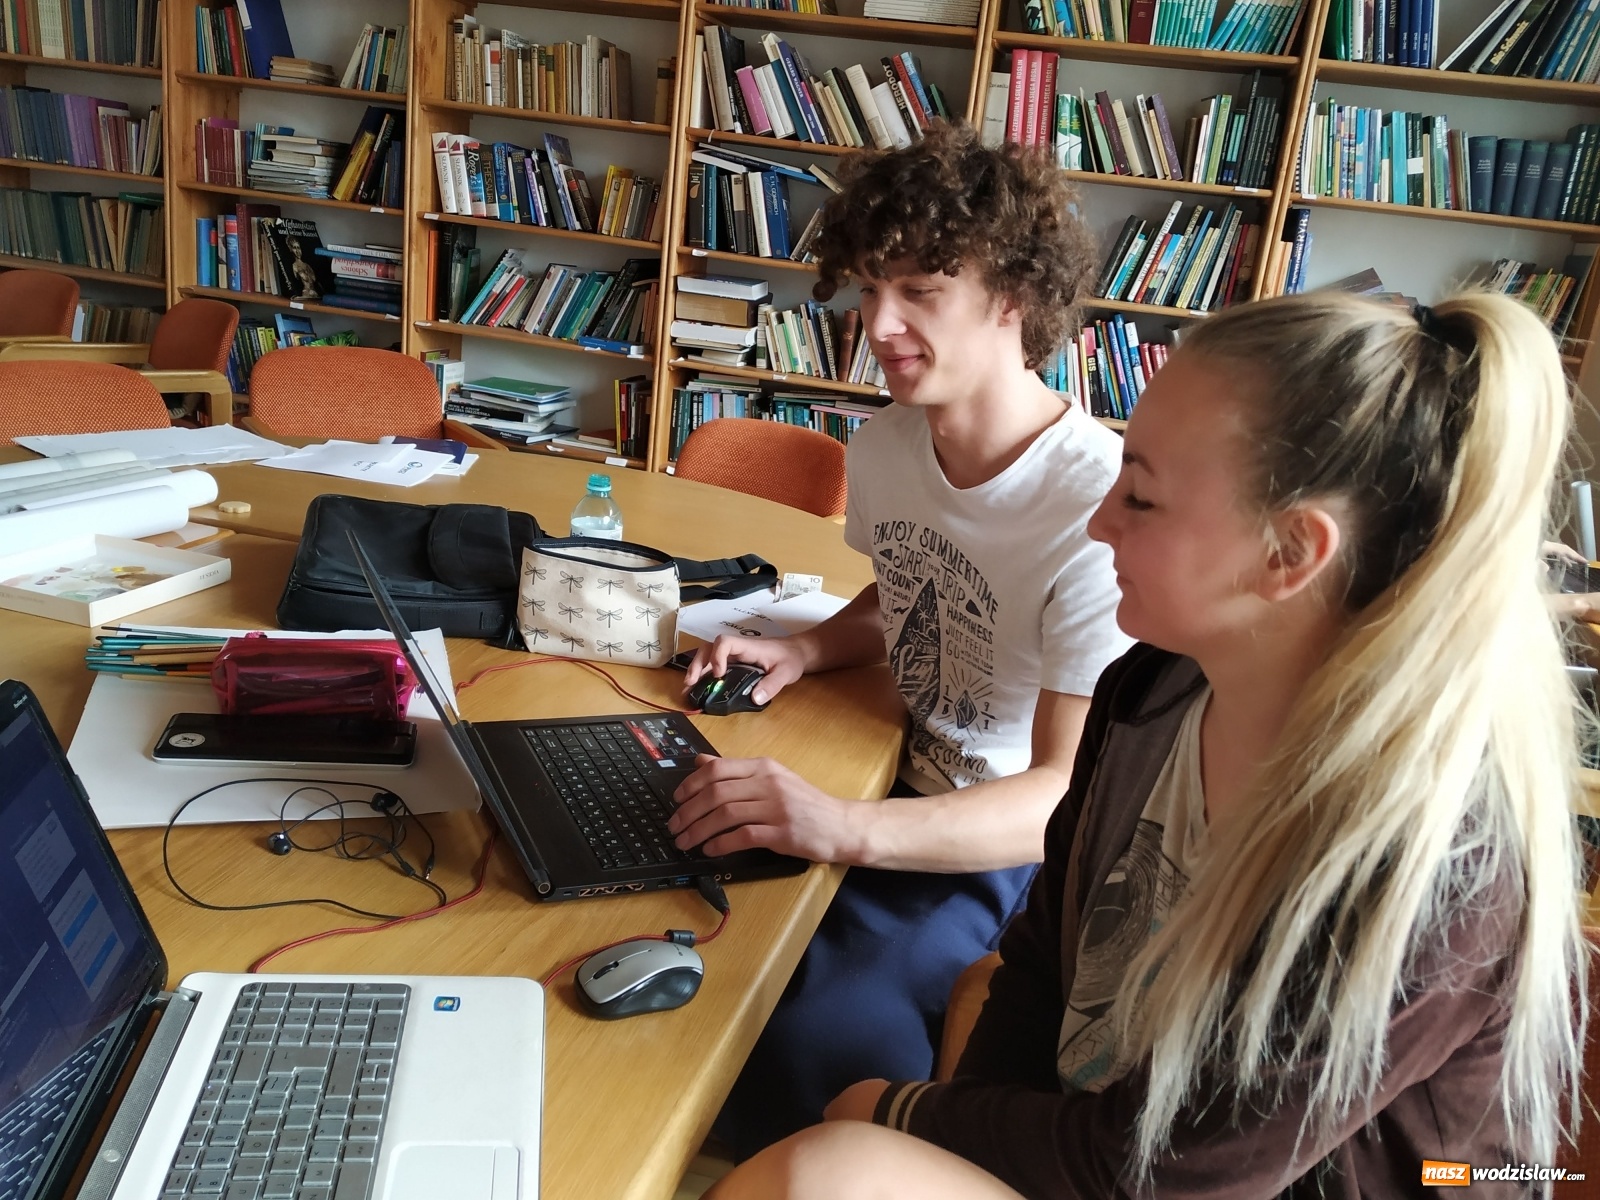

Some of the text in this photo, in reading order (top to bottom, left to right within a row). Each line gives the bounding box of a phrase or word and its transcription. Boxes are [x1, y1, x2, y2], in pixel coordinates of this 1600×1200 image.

[883, 63, 907, 110] HERODOT
[1088, 357, 1097, 372] GIS
[809, 576, 821, 584] 10
[873, 520, 999, 626] ENJOY SUMMERTIME
[886, 568, 916, 595] COUNT
[892, 543, 932, 576] START
[940, 562, 966, 608] TRIP
[945, 623, 964, 644] JUST
[965, 635, 983, 656] FEEL
[986, 648, 995, 661] IT
[946, 603, 994, 645] HAPPINESS
[946, 640, 960, 660] GO
